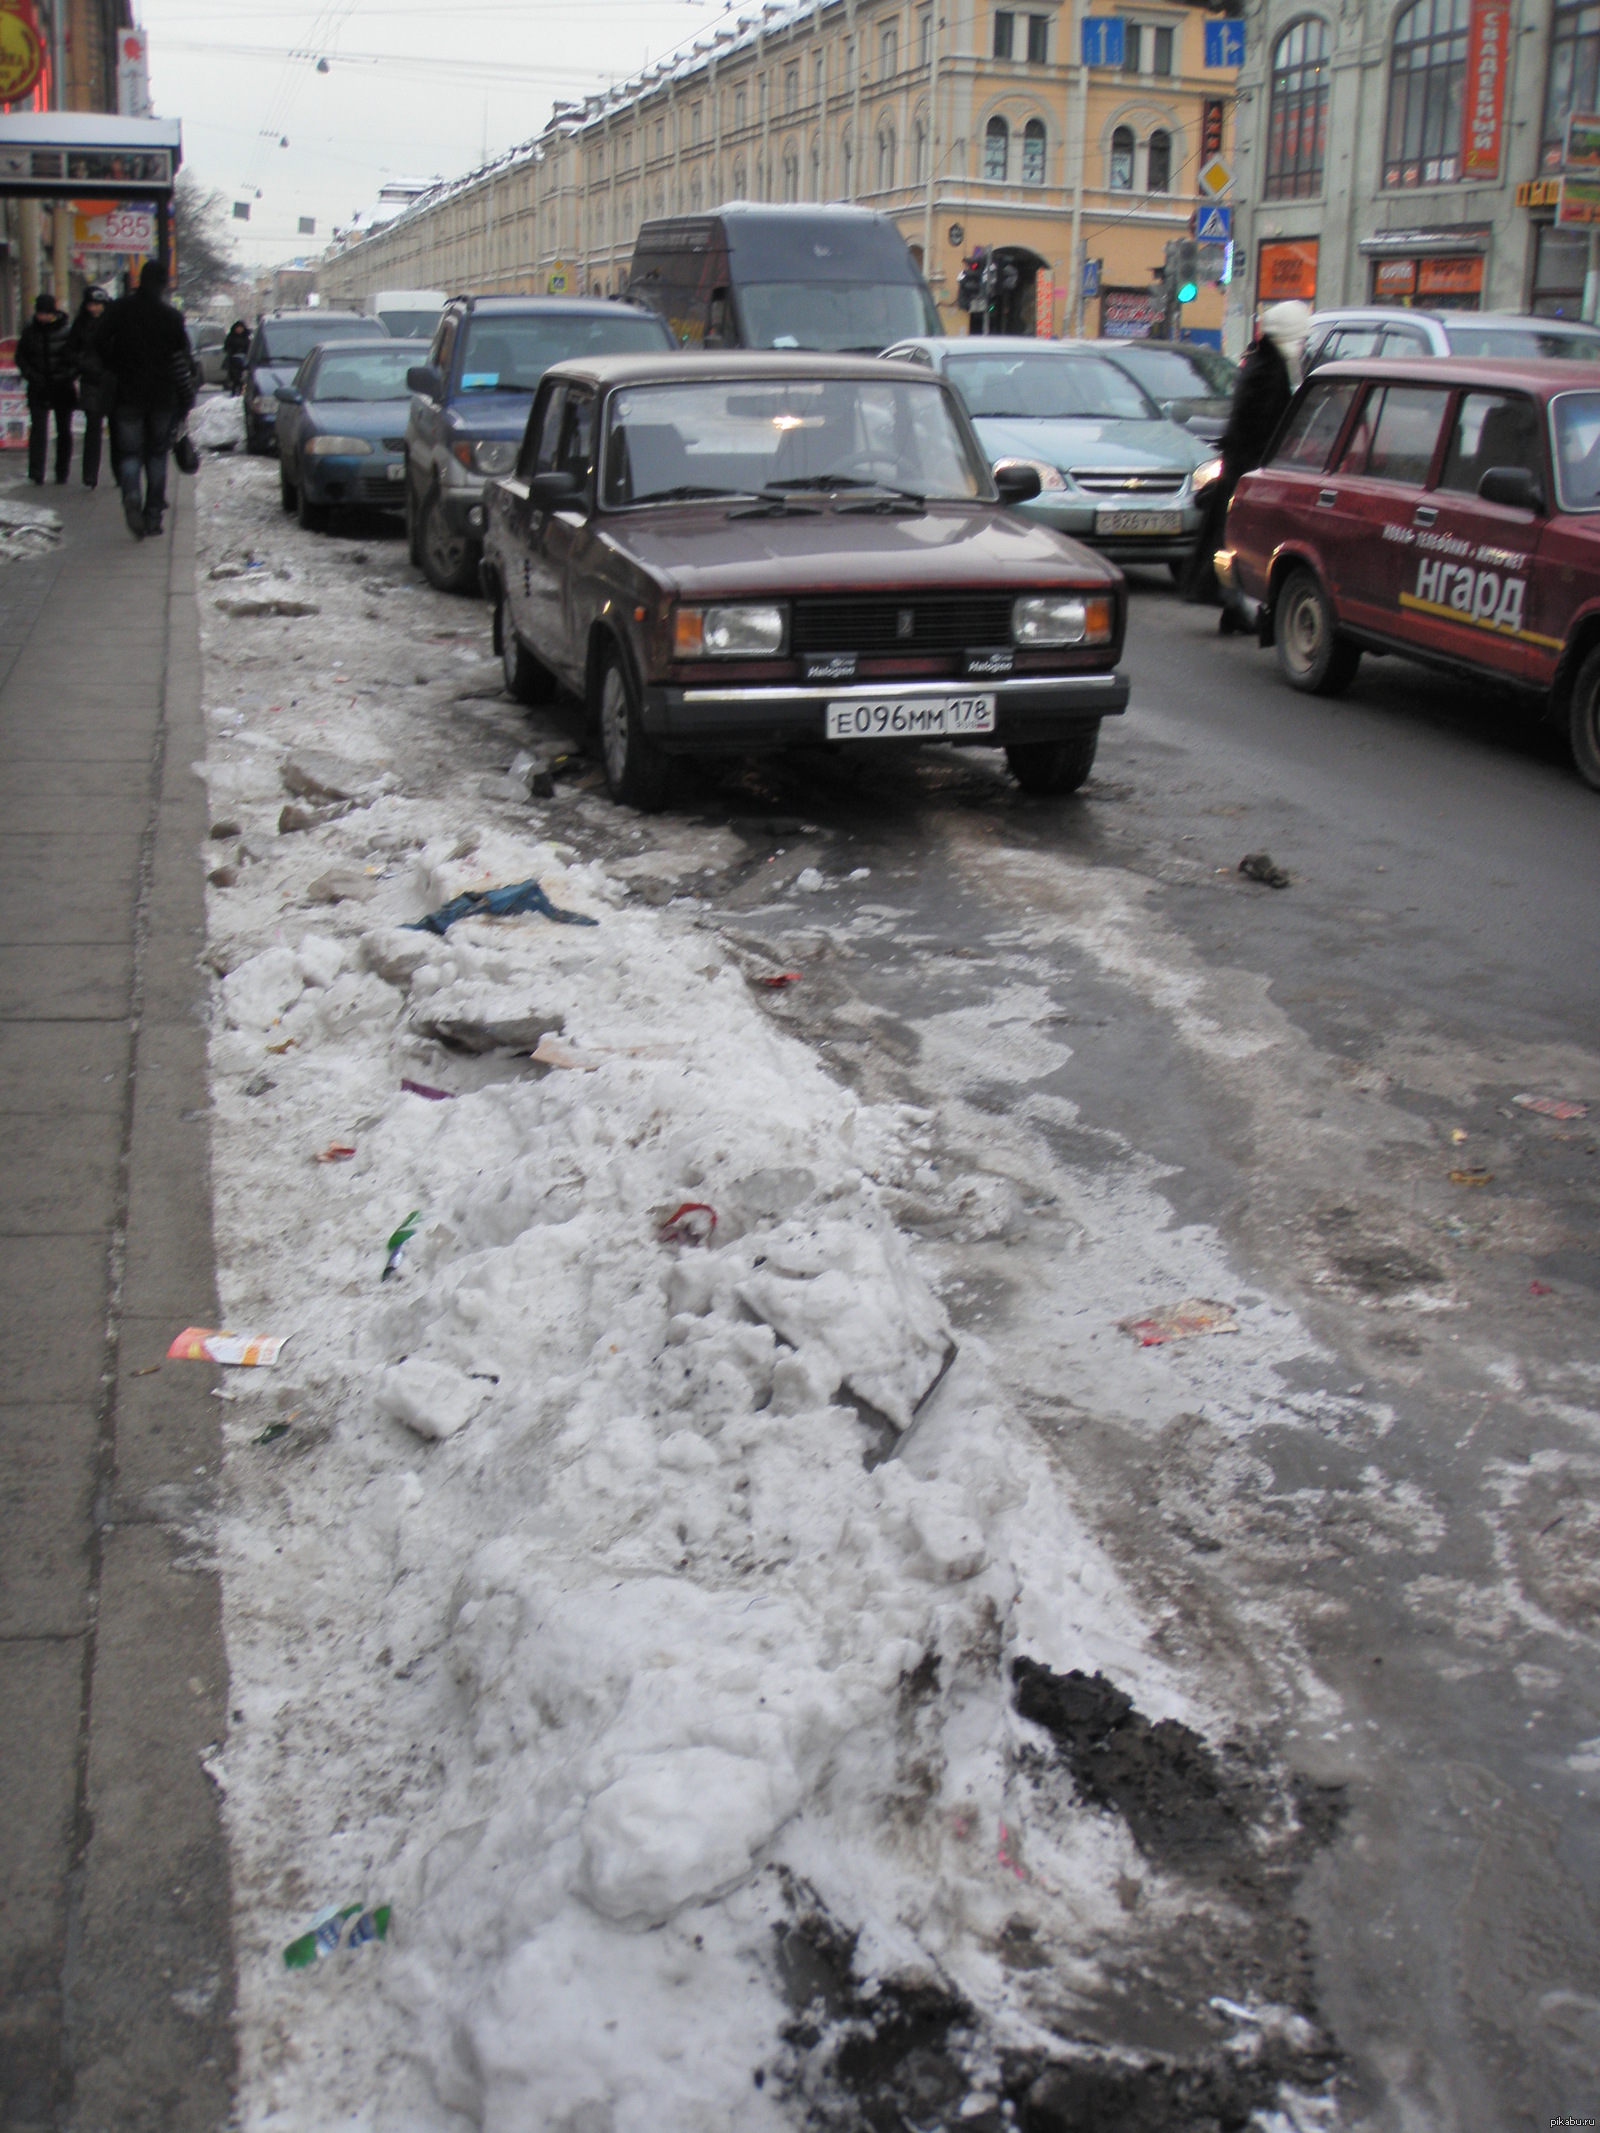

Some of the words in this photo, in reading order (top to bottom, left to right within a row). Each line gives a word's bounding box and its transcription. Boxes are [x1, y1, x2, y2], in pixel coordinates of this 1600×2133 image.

[105, 214, 150, 238] 585
[1415, 557, 1527, 632] нгард
[807, 666, 856, 679] Halogen
[967, 661, 1014, 674] Halogen
